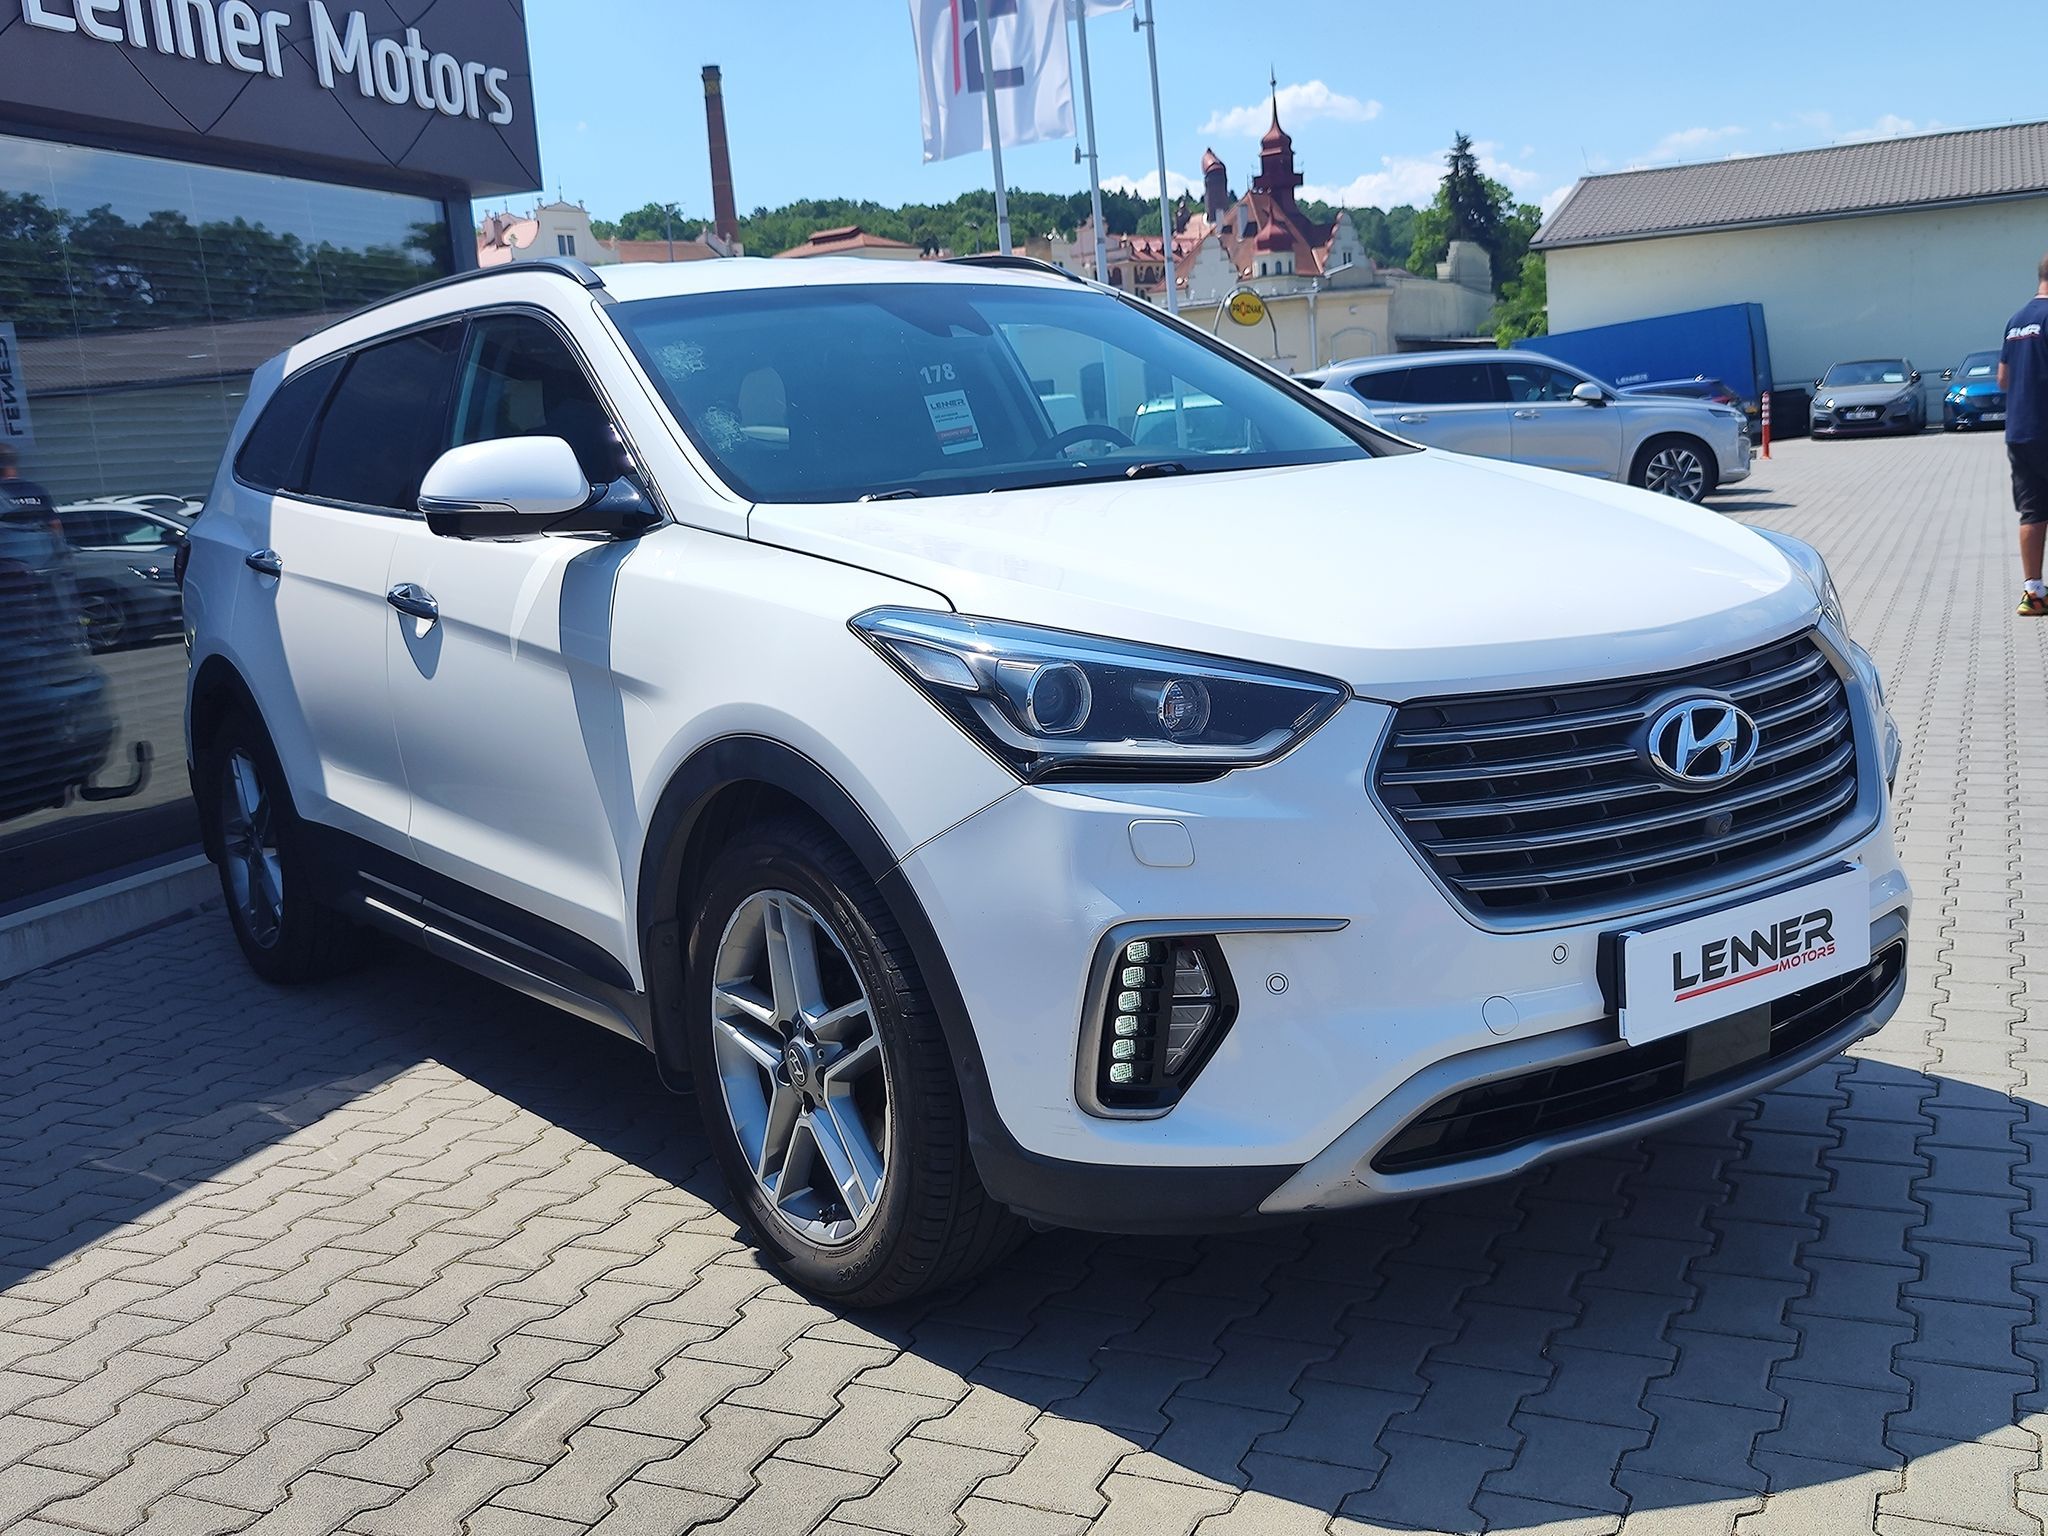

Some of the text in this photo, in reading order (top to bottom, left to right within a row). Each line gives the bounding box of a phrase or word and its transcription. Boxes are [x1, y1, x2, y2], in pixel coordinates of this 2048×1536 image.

[311, 1, 514, 126] Motors
[919, 363, 956, 385] 178
[1673, 908, 1835, 991] LENNER
[1778, 942, 1836, 973] MOTORS
